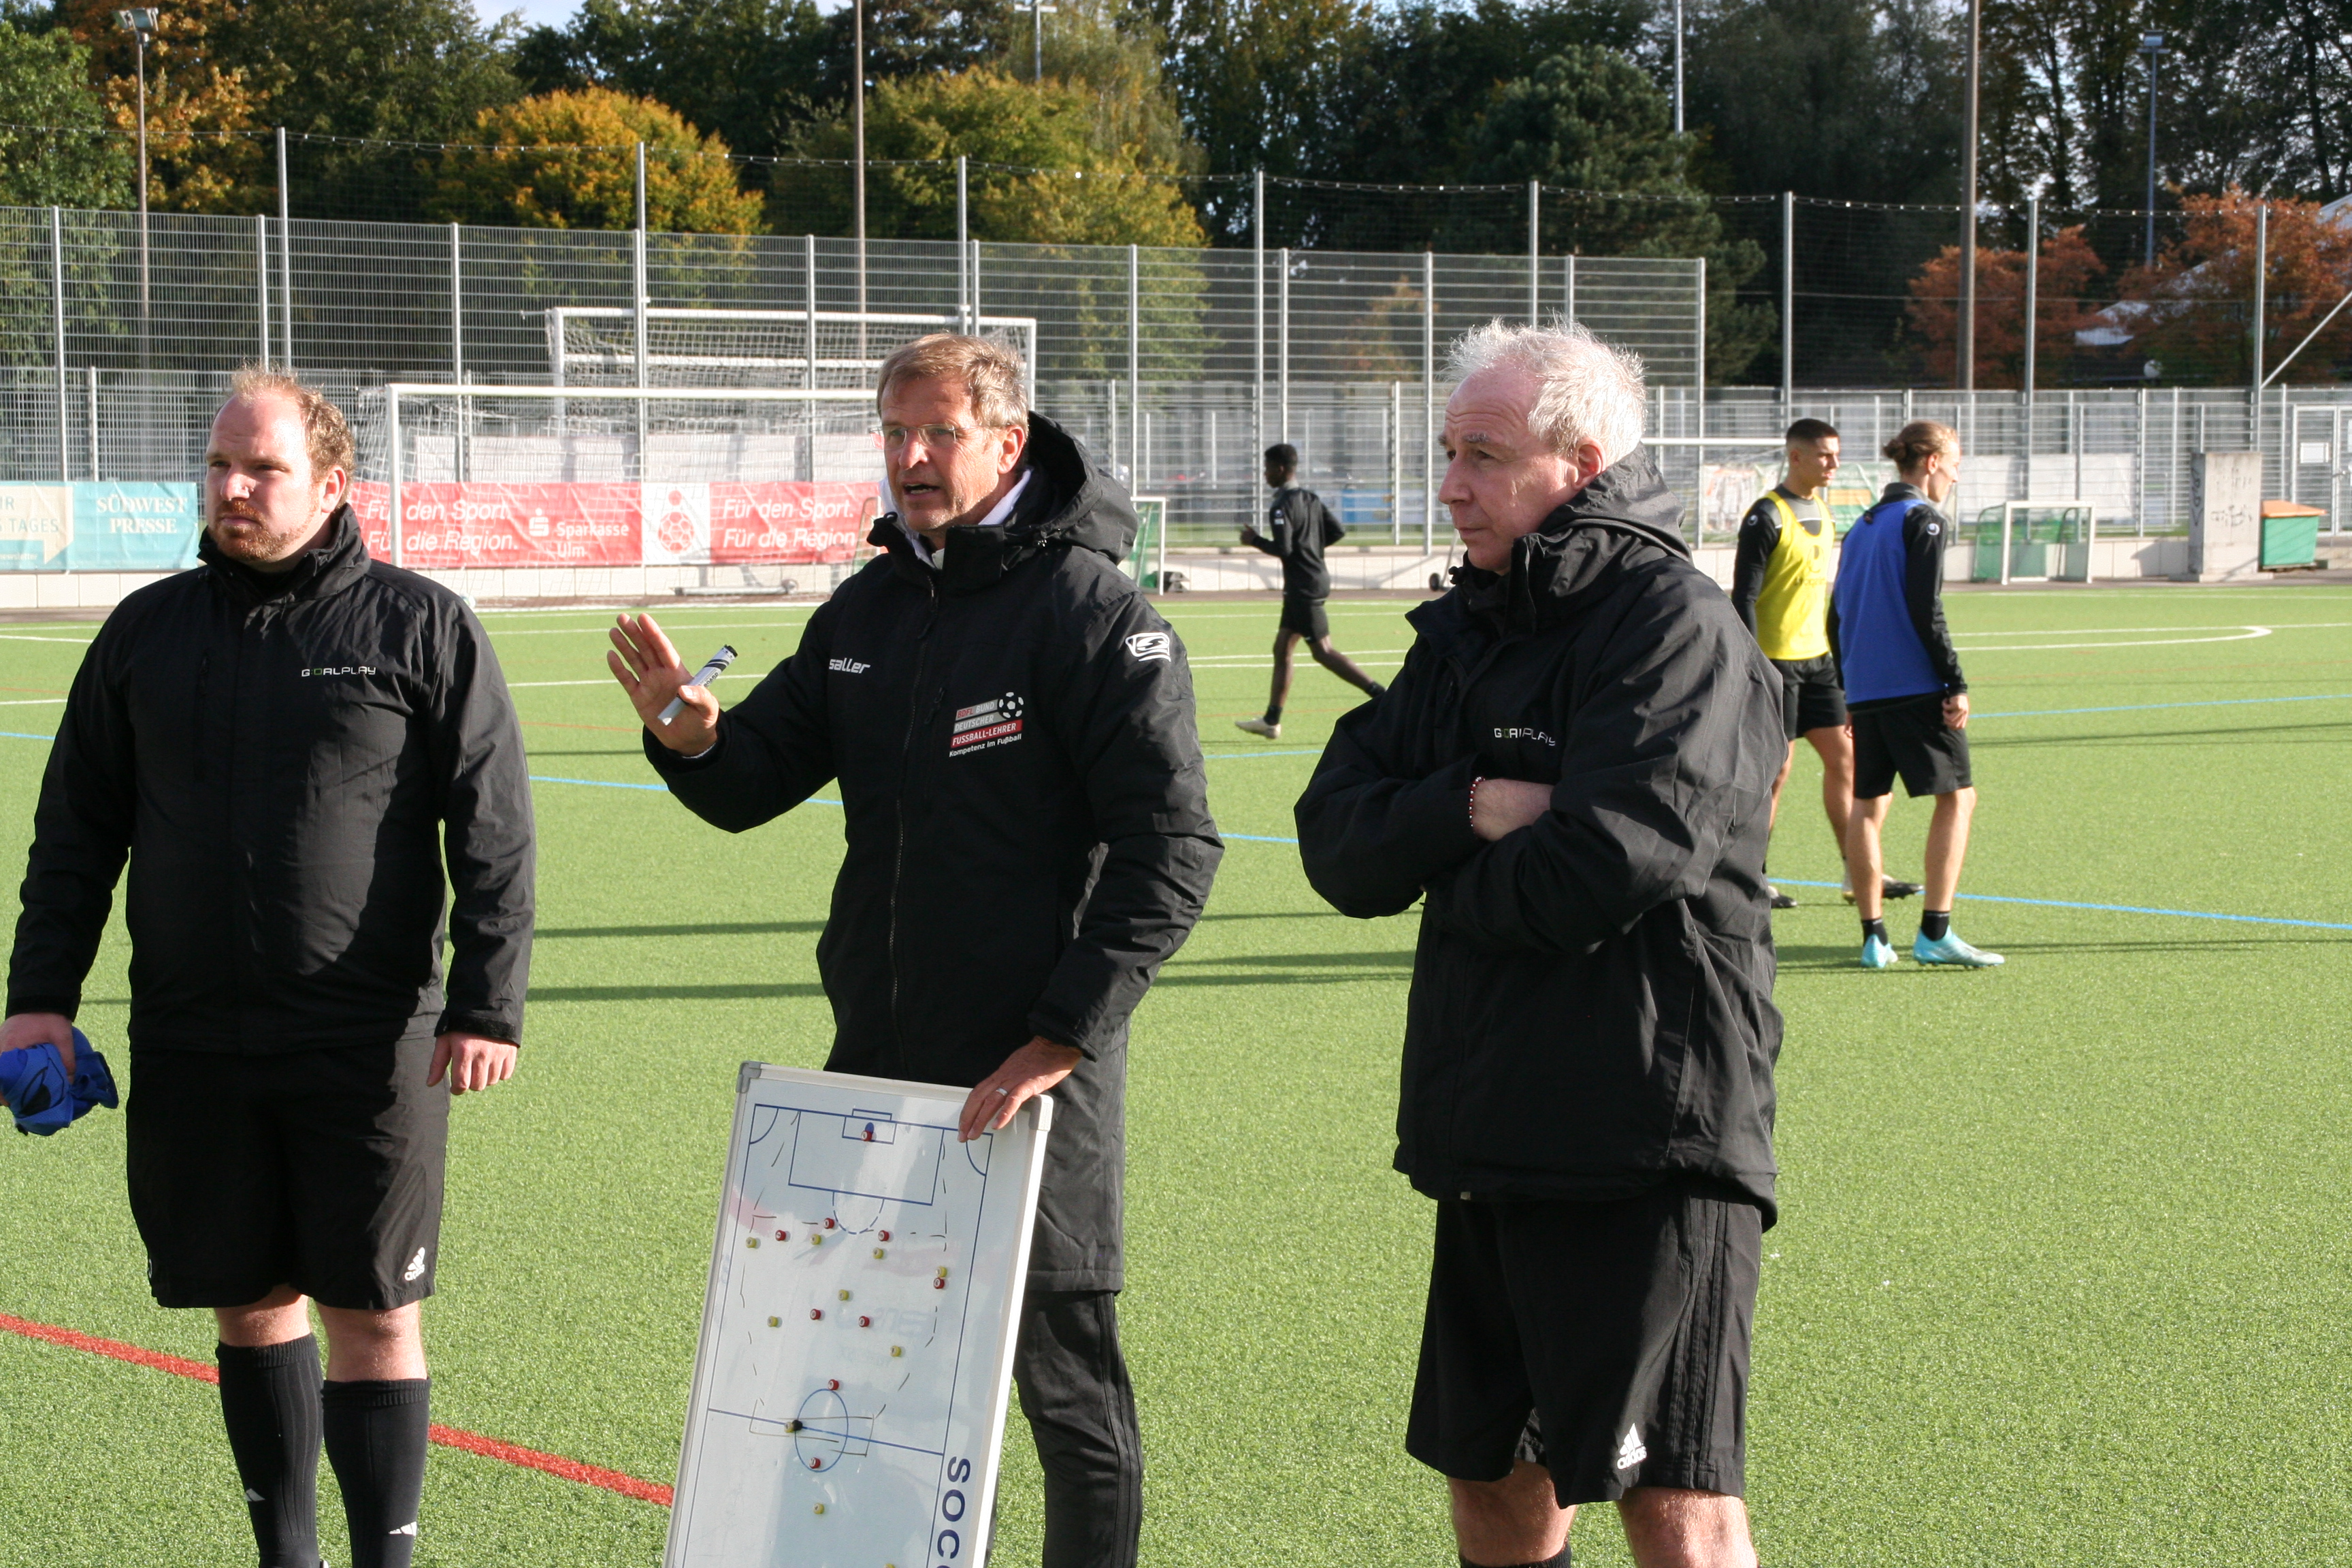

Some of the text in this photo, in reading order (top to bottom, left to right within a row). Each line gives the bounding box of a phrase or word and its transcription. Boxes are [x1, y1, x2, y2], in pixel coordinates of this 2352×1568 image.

[97, 493, 188, 513] SÜDWEST
[367, 500, 391, 521] Fü
[406, 500, 444, 521] den
[723, 498, 853, 523] Für den Sport.
[9, 518, 59, 533] TAGES
[110, 519, 177, 534] PRESSE
[557, 521, 629, 540] Sparkasse
[368, 530, 518, 557] Fü die Region.
[723, 528, 755, 548] Für
[758, 528, 787, 548] die
[557, 542, 585, 557] Ulm
[301, 666, 376, 677] GOALPLAY
[828, 657, 871, 674] saller
[954, 715, 994, 732] DEUTSCHER
[952, 723, 1017, 746] FUSSBALL-LEHRER
[949, 743, 985, 757] Kompetenz
[997, 733, 1022, 745] Fußball
[936, 1456, 971, 1568] SOC
